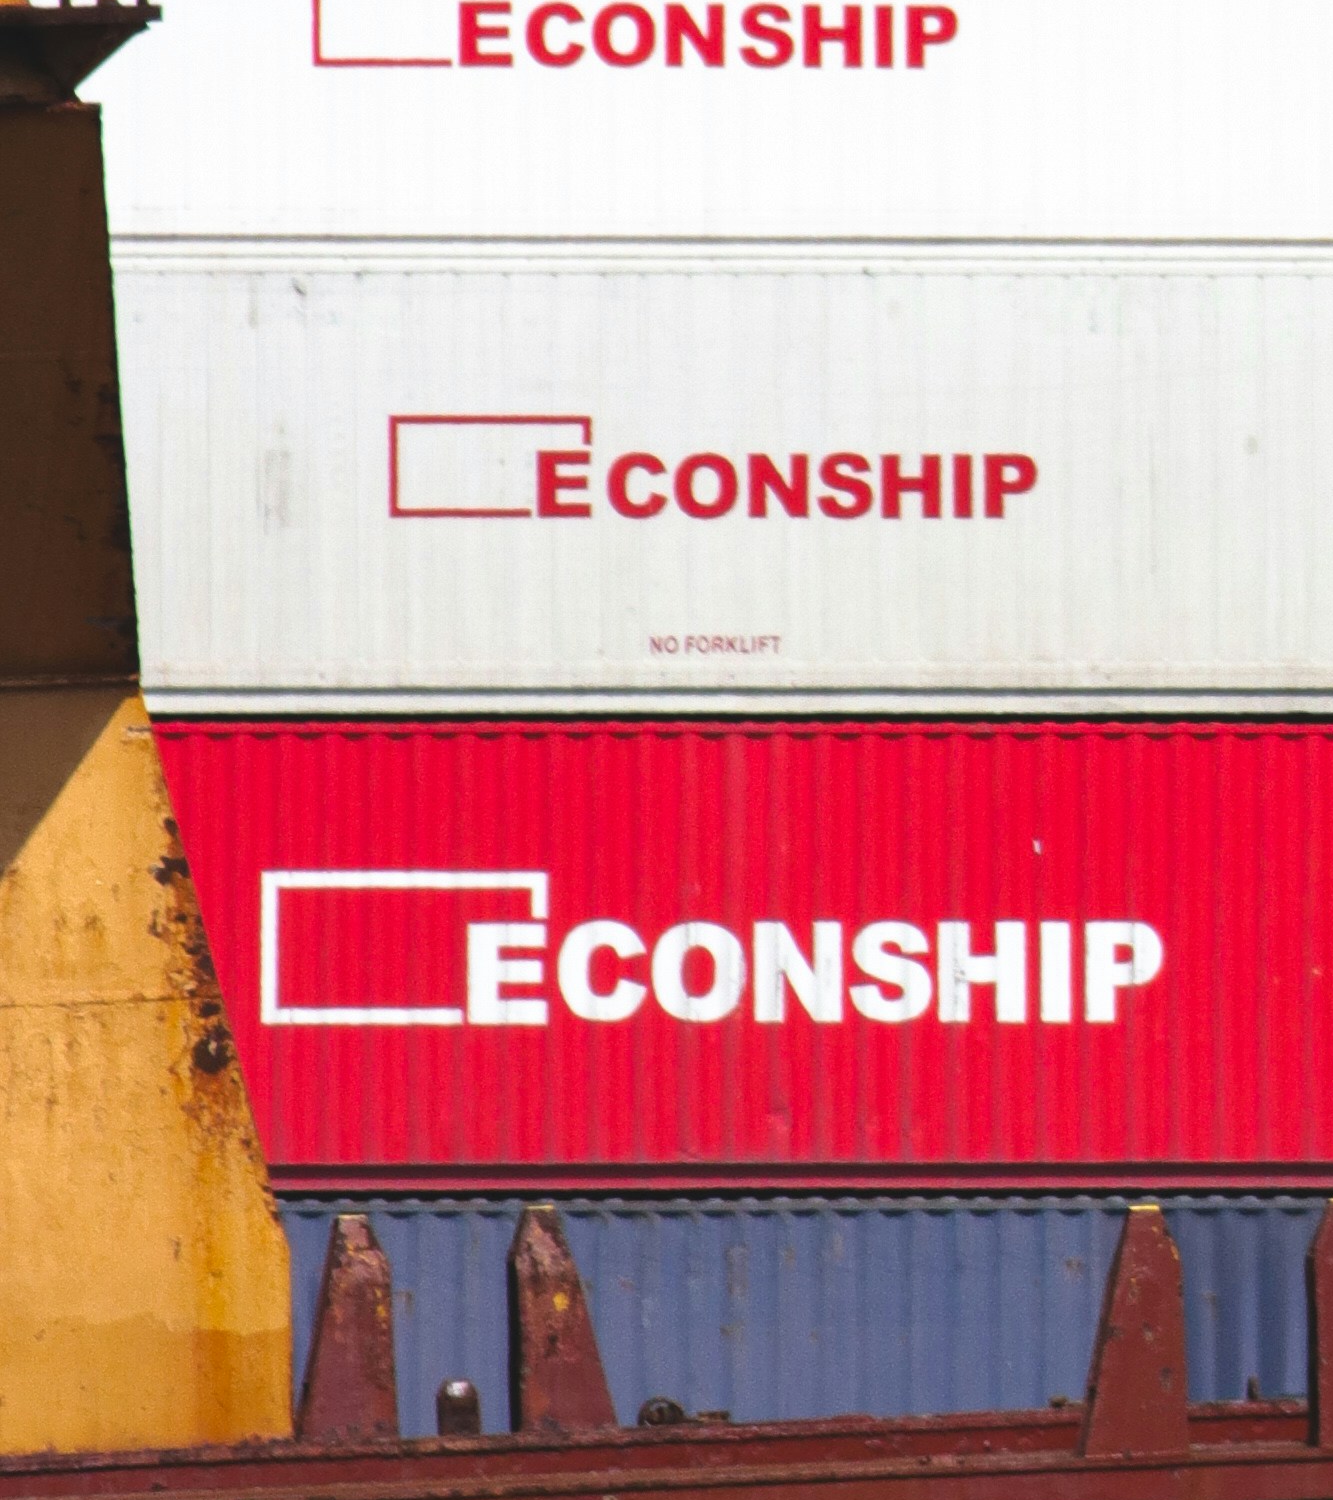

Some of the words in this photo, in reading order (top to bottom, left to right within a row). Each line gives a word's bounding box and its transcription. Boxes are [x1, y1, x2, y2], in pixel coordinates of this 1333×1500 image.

[459, 1, 957, 69] ECONSHIP
[537, 451, 1038, 519] ECONSHIP
[648, 634, 679, 654] NO
[684, 634, 781, 654] FORKLIFT
[467, 916, 1164, 1026] ECONSHIP
